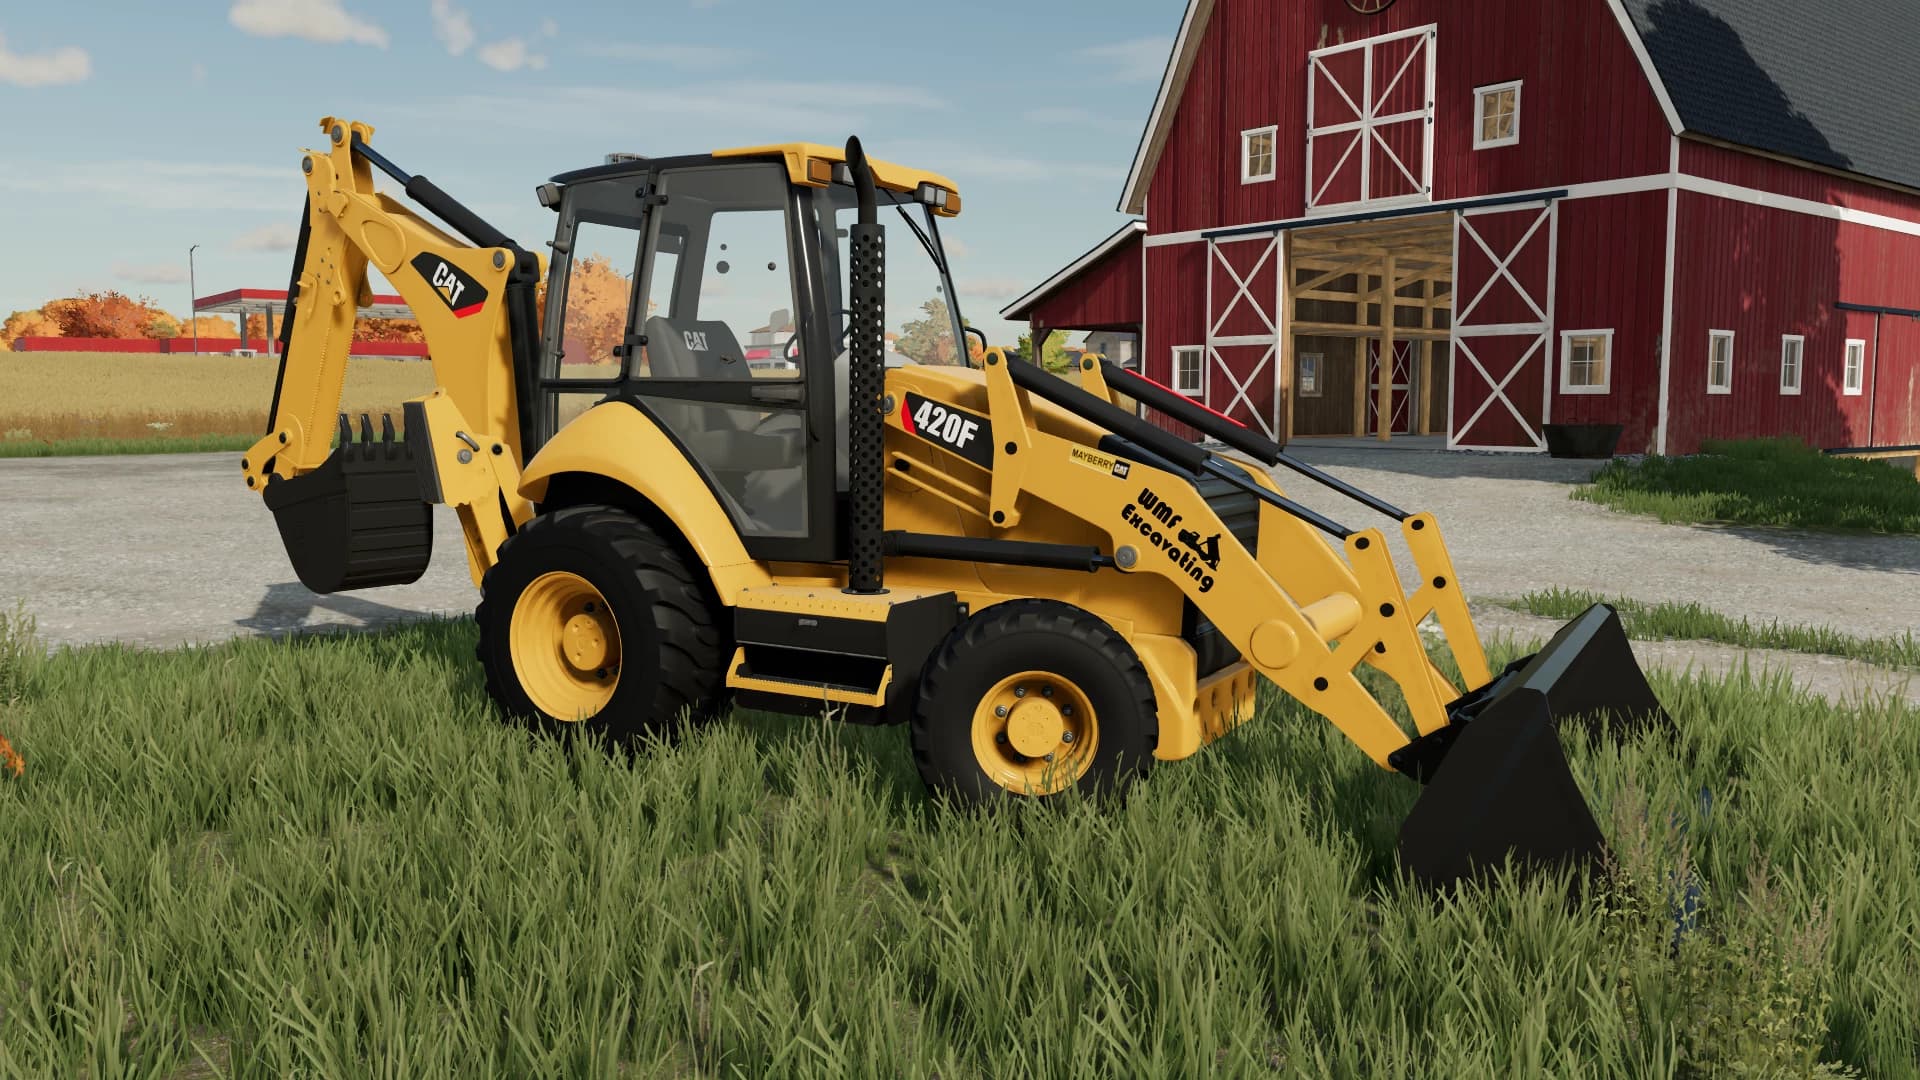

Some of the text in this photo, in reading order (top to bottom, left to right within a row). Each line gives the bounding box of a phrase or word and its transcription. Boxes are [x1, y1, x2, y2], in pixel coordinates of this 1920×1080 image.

[432, 261, 465, 306] CAT
[683, 330, 708, 351] CAT
[913, 400, 979, 448] 420F
[1072, 448, 1129, 476] MAYBERRY CAT
[1121, 503, 1214, 592] Excavating
